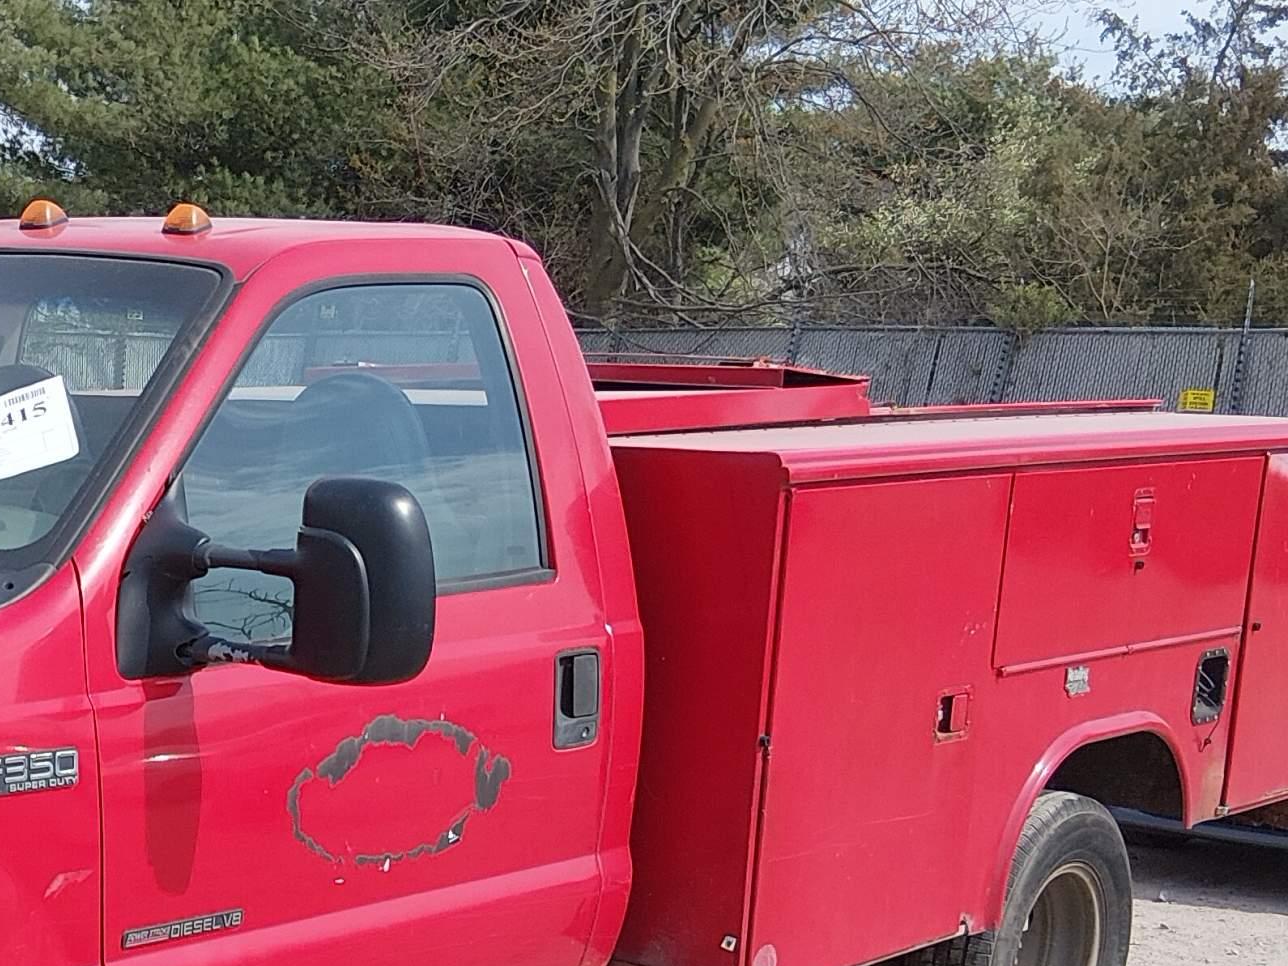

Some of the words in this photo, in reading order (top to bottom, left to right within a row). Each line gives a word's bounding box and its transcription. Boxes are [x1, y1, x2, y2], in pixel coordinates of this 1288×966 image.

[9, 781, 46, 793] SUPER
[49, 776, 78, 787] DUTY
[170, 917, 221, 938] DIESEL
[223, 912, 242, 927] V8
